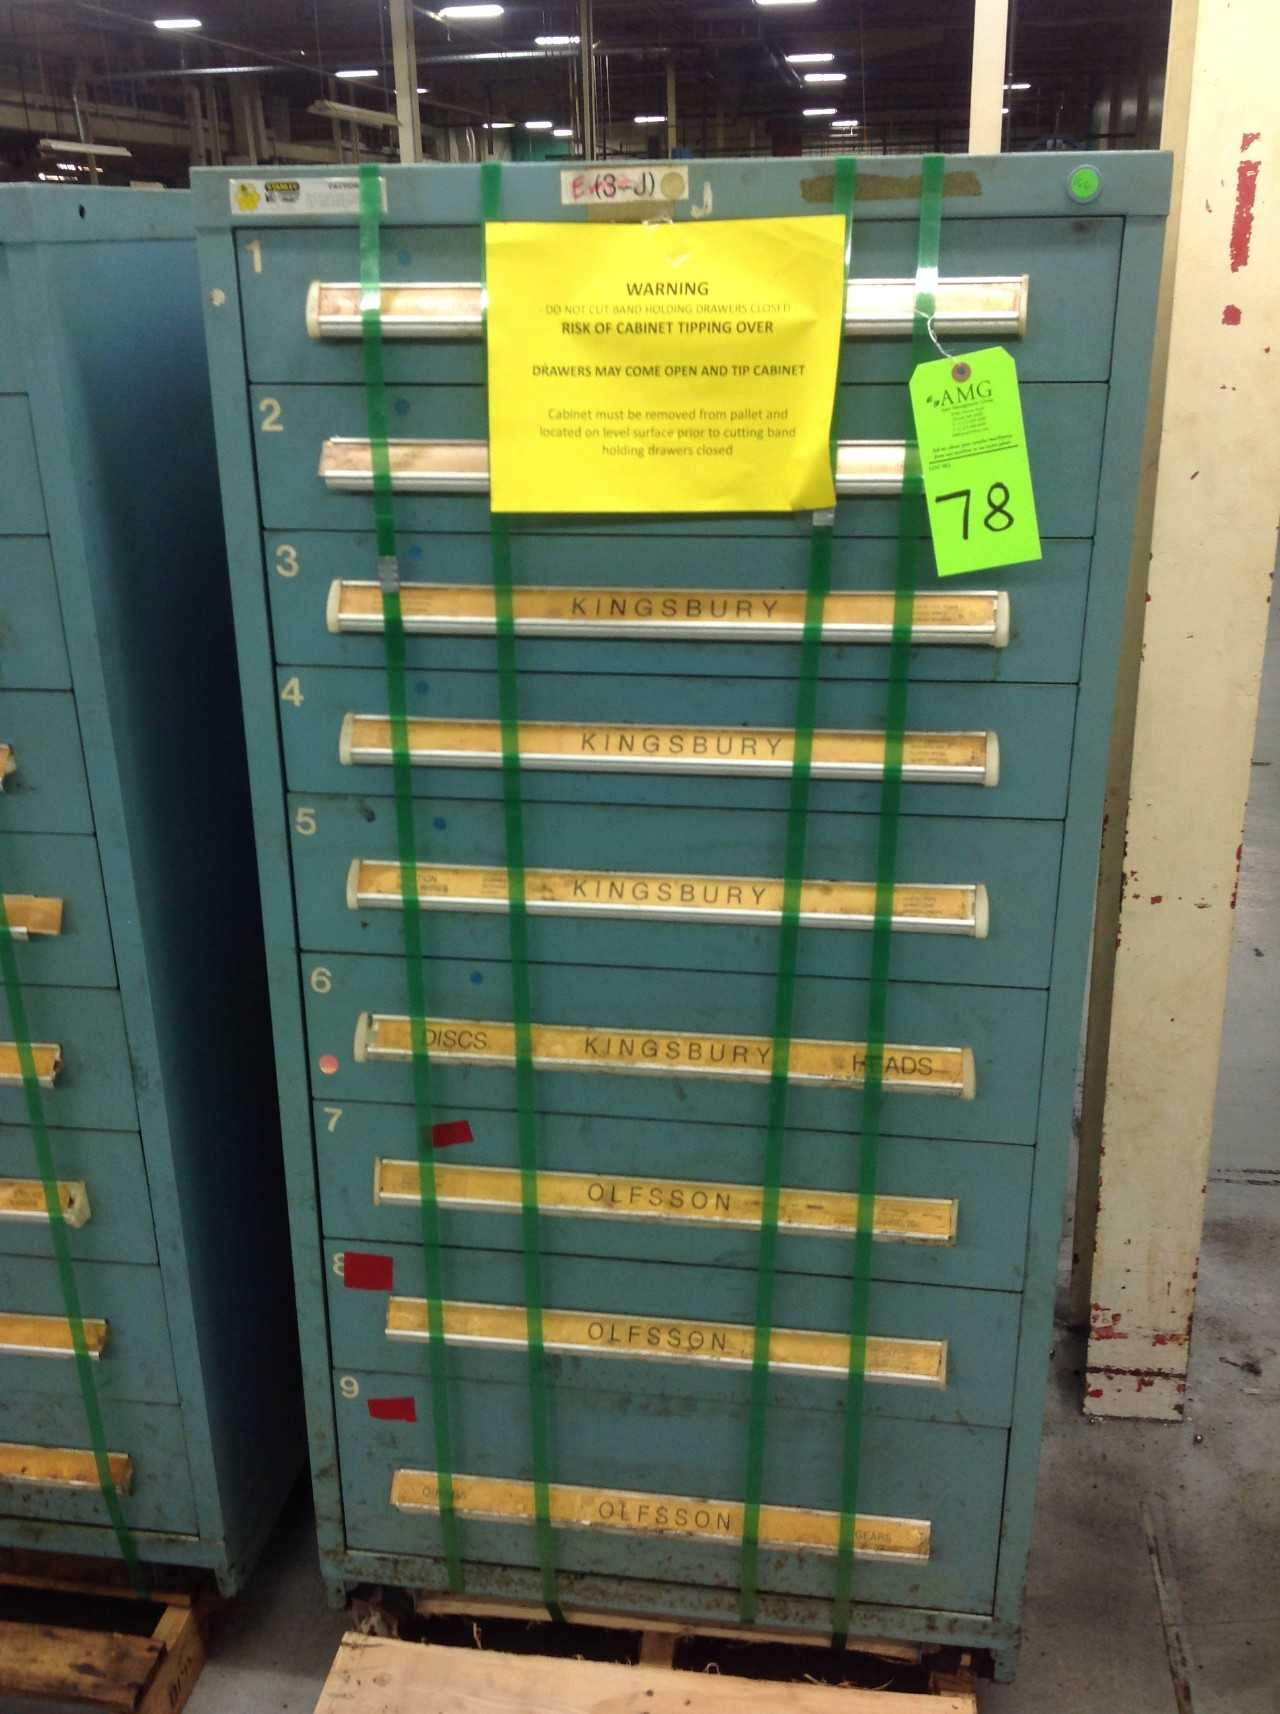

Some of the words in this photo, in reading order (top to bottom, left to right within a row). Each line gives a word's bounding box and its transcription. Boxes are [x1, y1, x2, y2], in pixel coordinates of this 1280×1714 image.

[246, 240, 263, 273] 1
[626, 281, 709, 296] WARNING
[546, 304, 562, 315] DO
[565, 304, 586, 315] NOT
[588, 304, 609, 315] CUT
[613, 304, 642, 315] BAND
[645, 304, 693, 315] HOLDING
[696, 303, 748, 314] DRAWERS
[750, 303, 791, 313] CLOSED
[562, 322, 591, 334] RISK
[595, 322, 612, 334] OF
[616, 322, 674, 334] CABINET
[678, 321, 732, 334] TIPPING
[736, 321, 774, 334] OVER
[532, 365, 591, 377] DRAWERS
[595, 365, 622, 376] MAY
[625, 365, 661, 377] COME
[664, 365, 698, 377] OPEN
[700, 365, 729, 377] AND
[731, 365, 750, 376] TIP
[753, 365, 806, 376] CABINET
[940, 380, 993, 407] AMG
[259, 398, 283, 432] 2
[548, 409, 593, 420] Cabinet
[596, 410, 624, 420] must
[627, 409, 642, 420] be
[645, 409, 696, 420] removed
[699, 408, 727, 420] from
[730, 408, 763, 422] pallet
[766, 409, 788, 420] and
[539, 427, 582, 438] located
[585, 428, 600, 438] on
[603, 427, 630, 438] level
[633, 427, 674, 438] surface
[677, 427, 705, 439] prior
[708, 428, 720, 438] to
[723, 427, 764, 440] cutting
[767, 426, 796, 438] band
[602, 445, 645, 458] holding
[648, 445, 694, 457] drawers
[696, 445, 733, 456] closed
[935, 482, 1015, 540] 78
[275, 544, 299, 577] 3
[571, 598, 778, 618] KINGSBURY
[281, 677, 304, 707] 4
[581, 733, 782, 755] KINGSBURY
[295, 807, 316, 836] 5
[573, 878, 766, 906] KINGSBURY
[311, 967, 332, 994] 6
[424, 1029, 488, 1049] DISCS
[584, 1037, 771, 1065] KINGSBURY
[323, 1107, 343, 1132] 7
[588, 1183, 731, 1211] OLFSSON
[588, 1322, 729, 1350] OLFSSON
[339, 1376, 359, 1398] 9
[599, 1501, 731, 1530] OLFSSON
